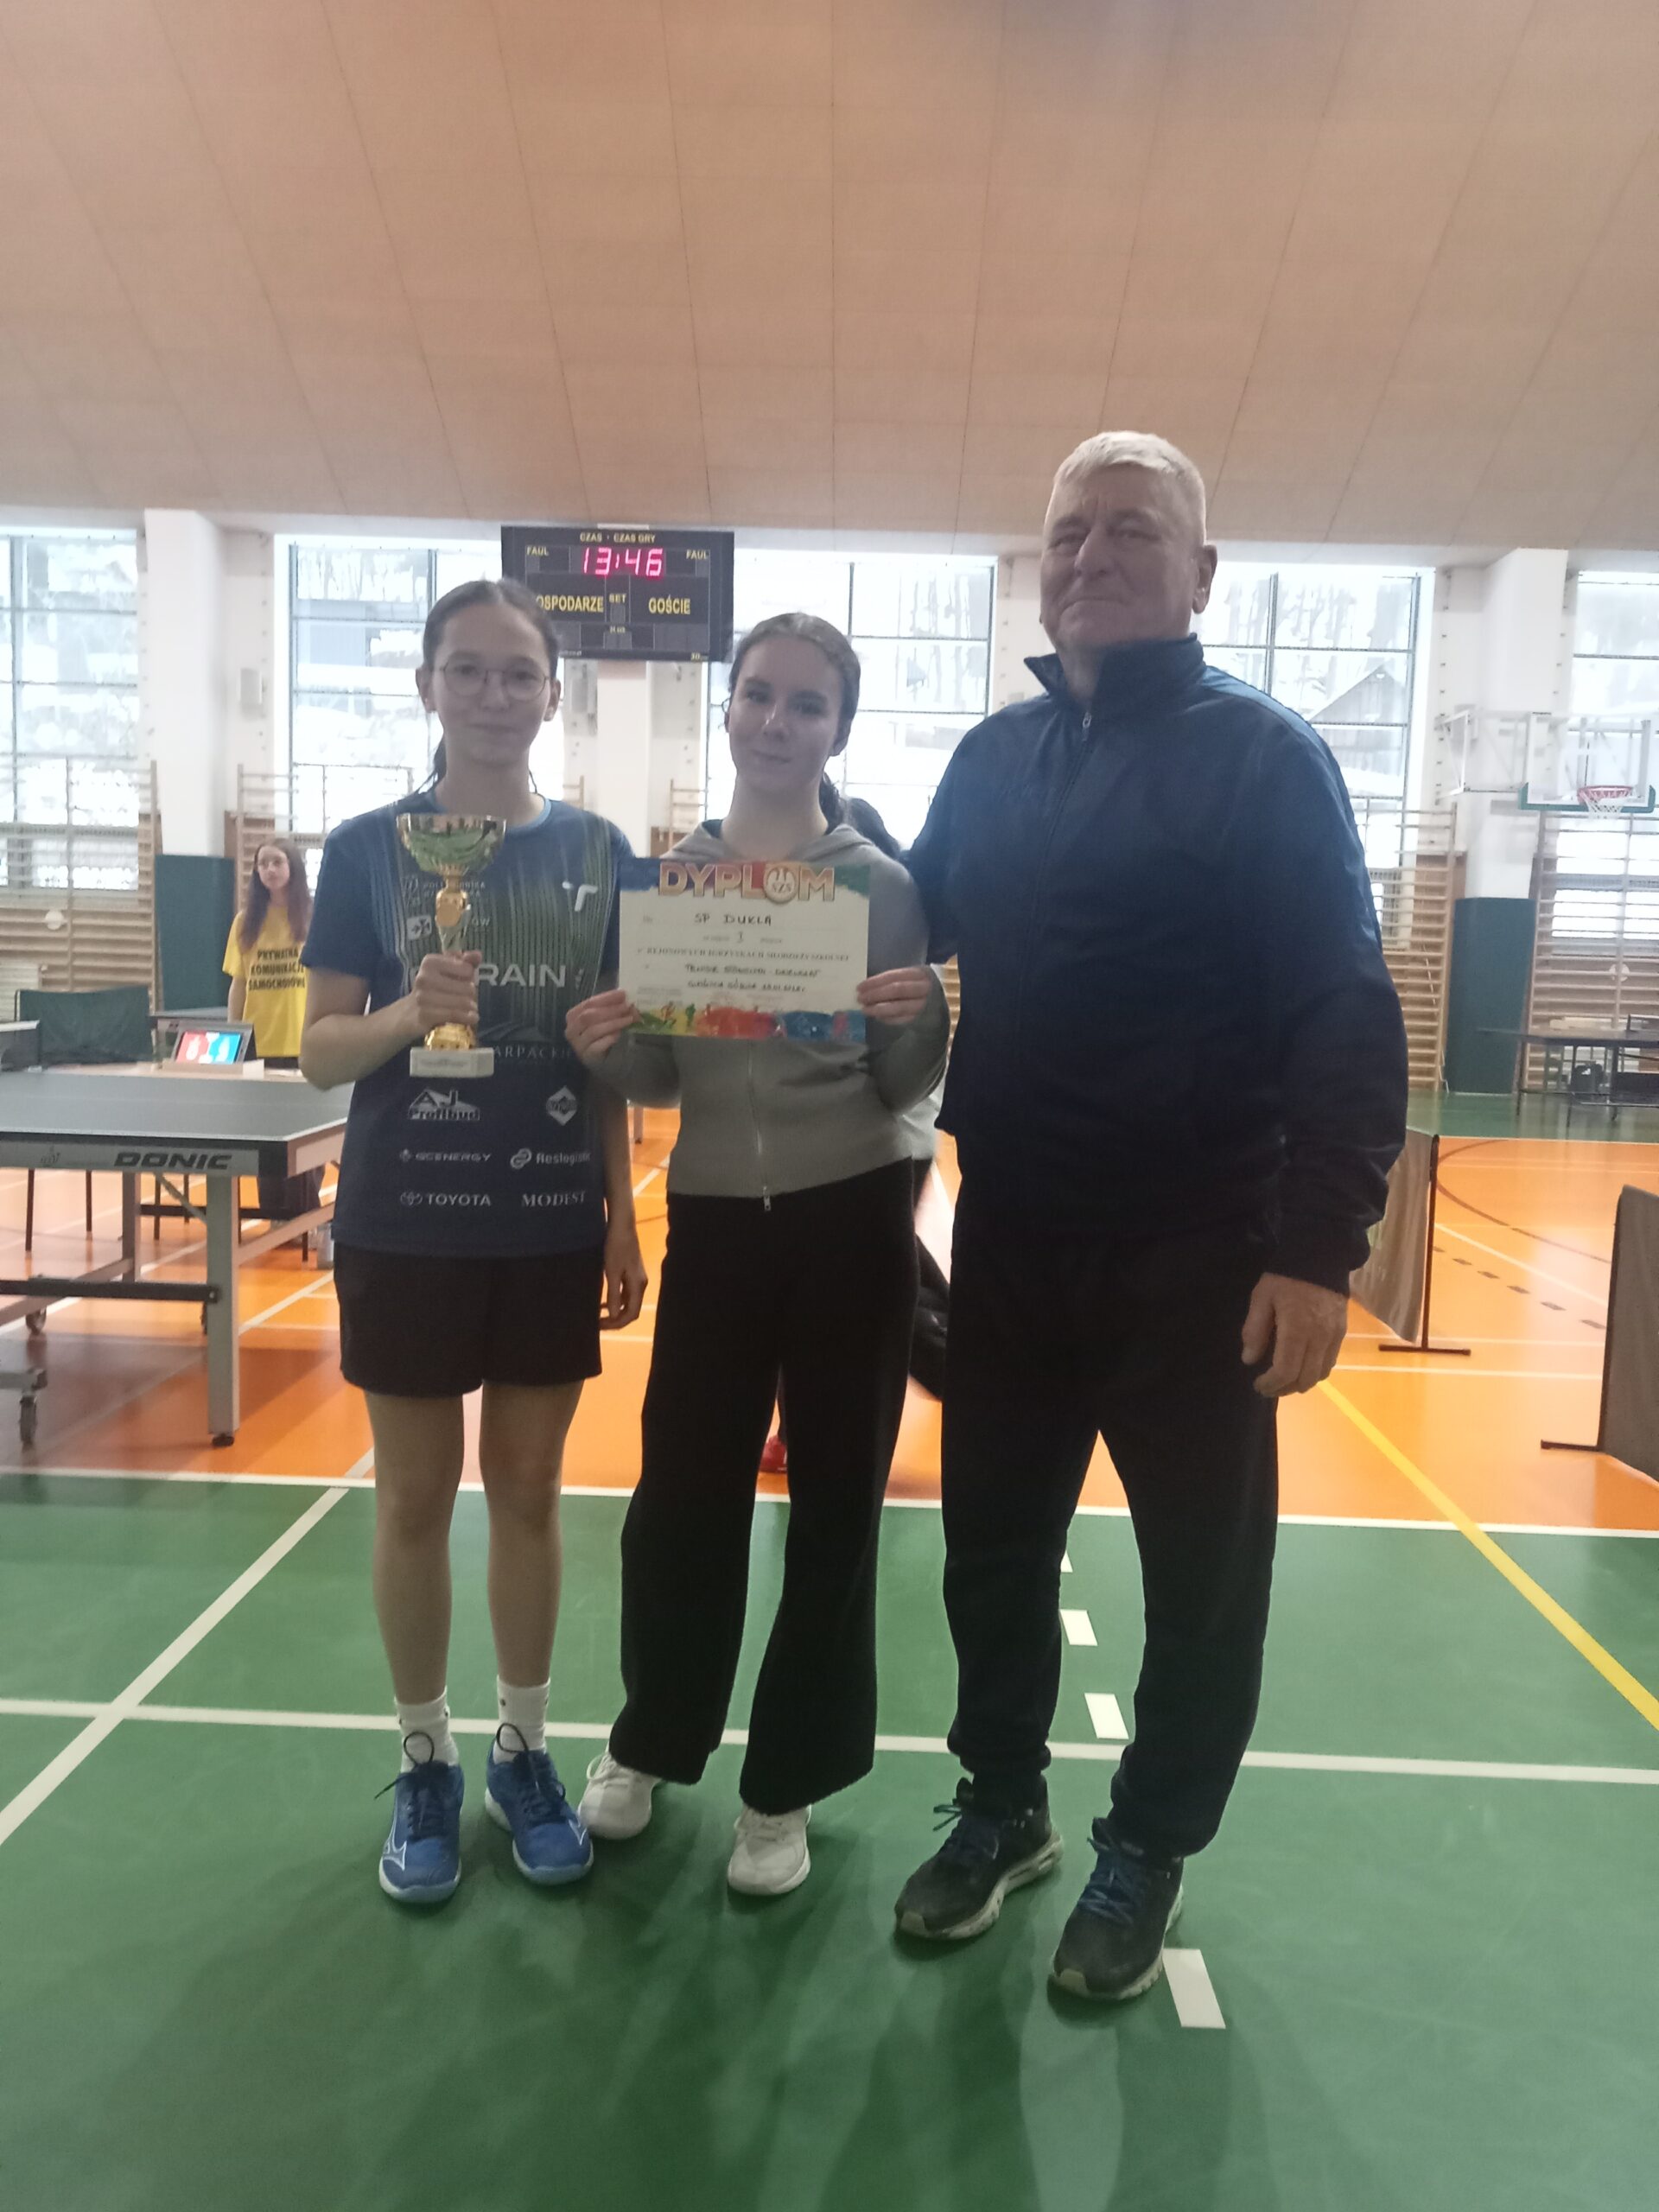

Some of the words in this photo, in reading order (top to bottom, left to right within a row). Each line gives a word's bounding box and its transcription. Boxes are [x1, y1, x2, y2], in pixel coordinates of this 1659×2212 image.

[526, 546, 549, 556] FAUL
[686, 550, 708, 559] FAUL
[583, 547, 664, 576] 13:46
[536, 594, 604, 613] OSPODARZE
[649, 594, 690, 614] GOŚCIE
[659, 863, 836, 904] DYPLOM
[114, 1152, 232, 1170] DONIC
[427, 1193, 492, 1207] TOYOTA
